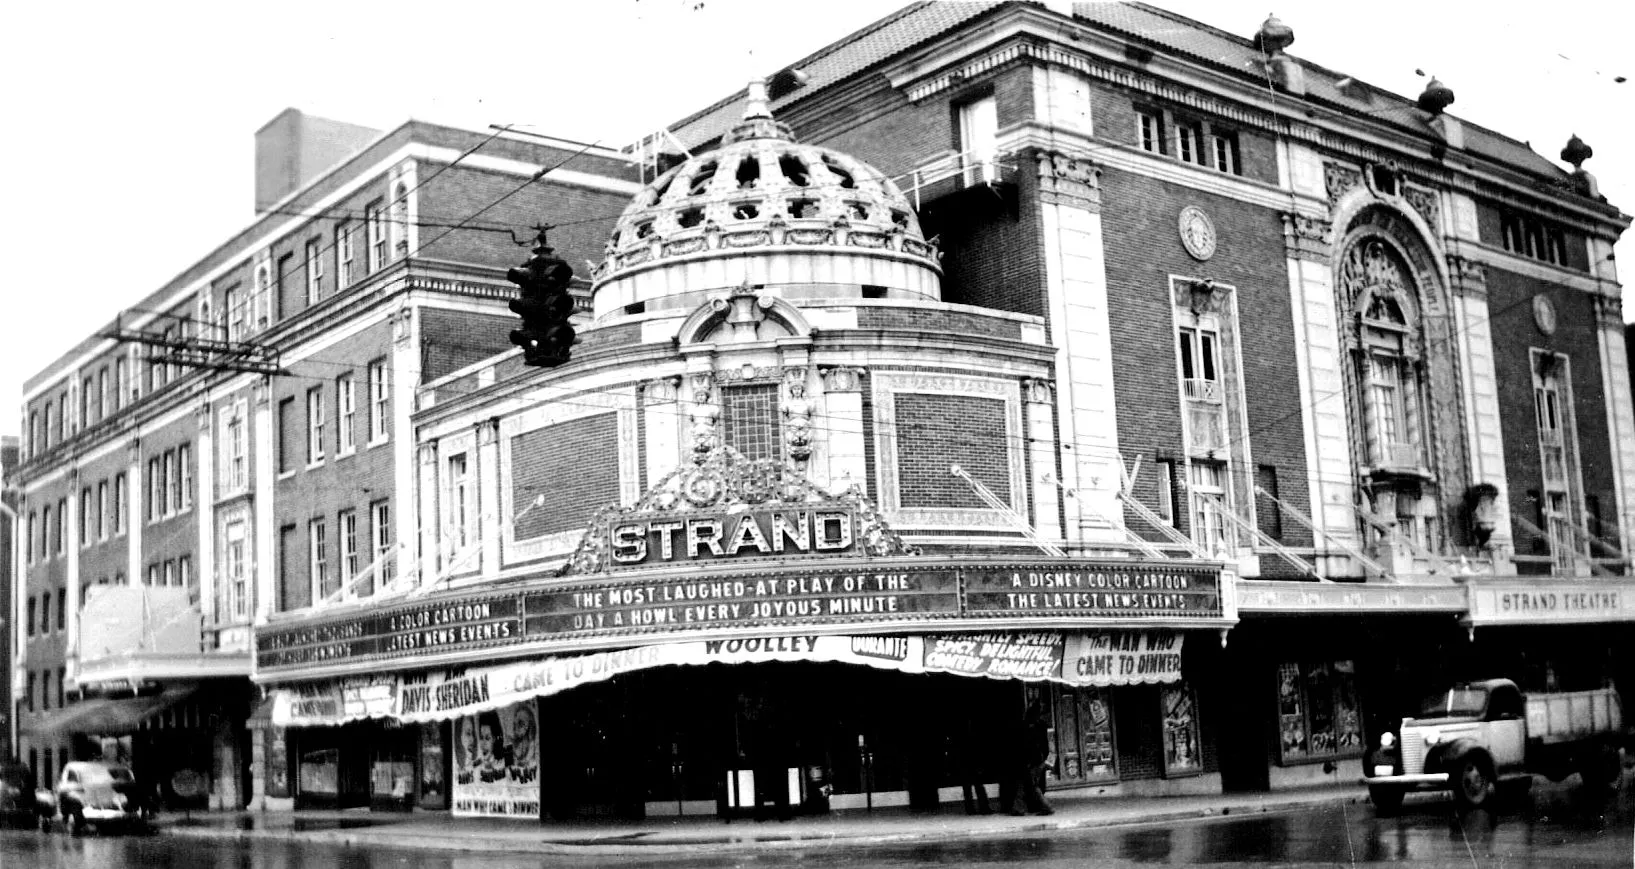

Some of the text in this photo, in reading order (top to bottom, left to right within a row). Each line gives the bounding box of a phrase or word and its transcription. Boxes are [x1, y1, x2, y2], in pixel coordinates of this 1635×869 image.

[612, 510, 853, 562] STRAND
[573, 574, 909, 607] THE MOST LAUGHED-AT PLAY OF THE
[1012, 573, 1188, 589] A DISNEY COLOR CARTOON
[1007, 593, 1186, 609] THE LATEST NEWS EVENTS
[1502, 592, 1618, 611] STRAND THEATRE
[391, 603, 490, 631] A COLOR CARTOON
[574, 597, 898, 629] DAY A HOWL EVERY JOYOUS MINUTE
[425, 628, 456, 646] NEWS
[461, 622, 510, 641] EVENTS
[706, 635, 820, 654] WOOLLEY
[852, 636, 908, 659] DURANTE
[980, 643, 1054, 661] DELIGHTFUL
[514, 647, 660, 692] CAME TO DINNER
[926, 652, 1062, 677] COMEDY ROMANCE!
[1077, 653, 1181, 676] CAME TO DINNER
[401, 686, 431, 716] DAVIS
[436, 674, 490, 711] SHERIDAN
[457, 801, 472, 812] MAN
